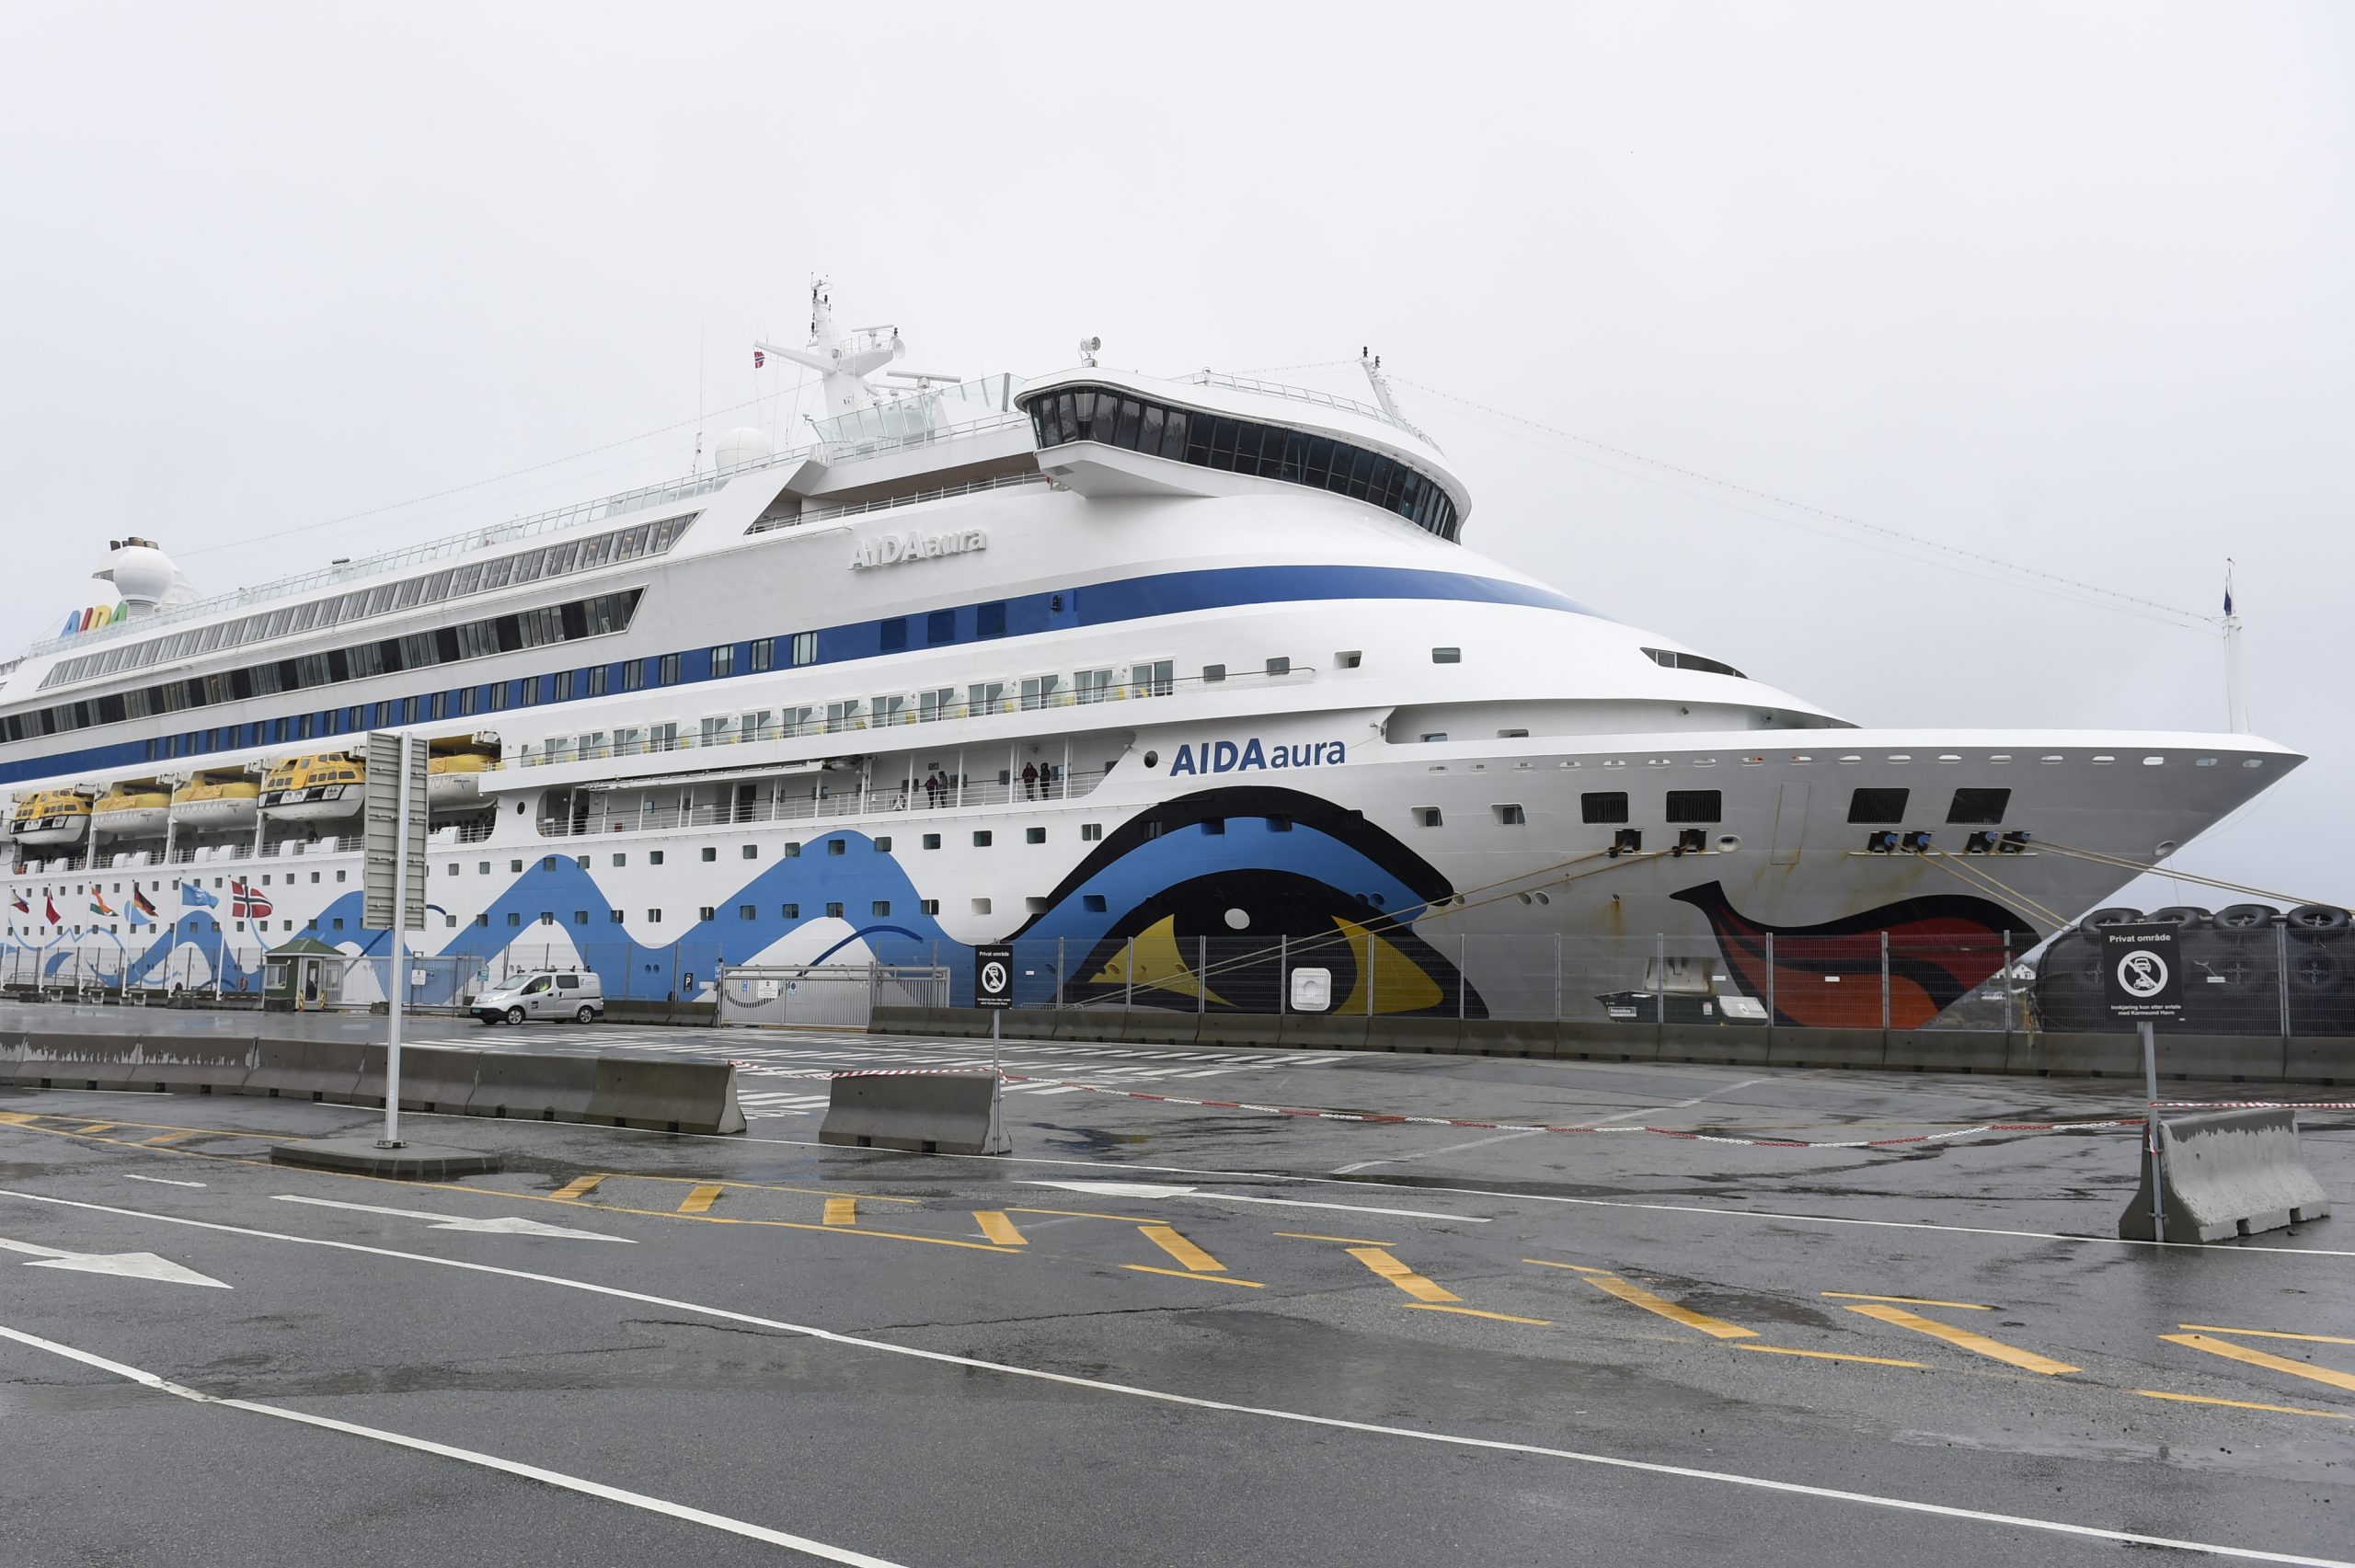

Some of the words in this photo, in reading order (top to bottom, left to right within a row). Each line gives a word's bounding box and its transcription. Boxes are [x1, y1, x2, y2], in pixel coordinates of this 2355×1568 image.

[847, 529, 986, 570] AIDAaura
[60, 601, 127, 638] AIDA
[2136, 933, 2171, 942] område
[685, 977, 691, 986] P
